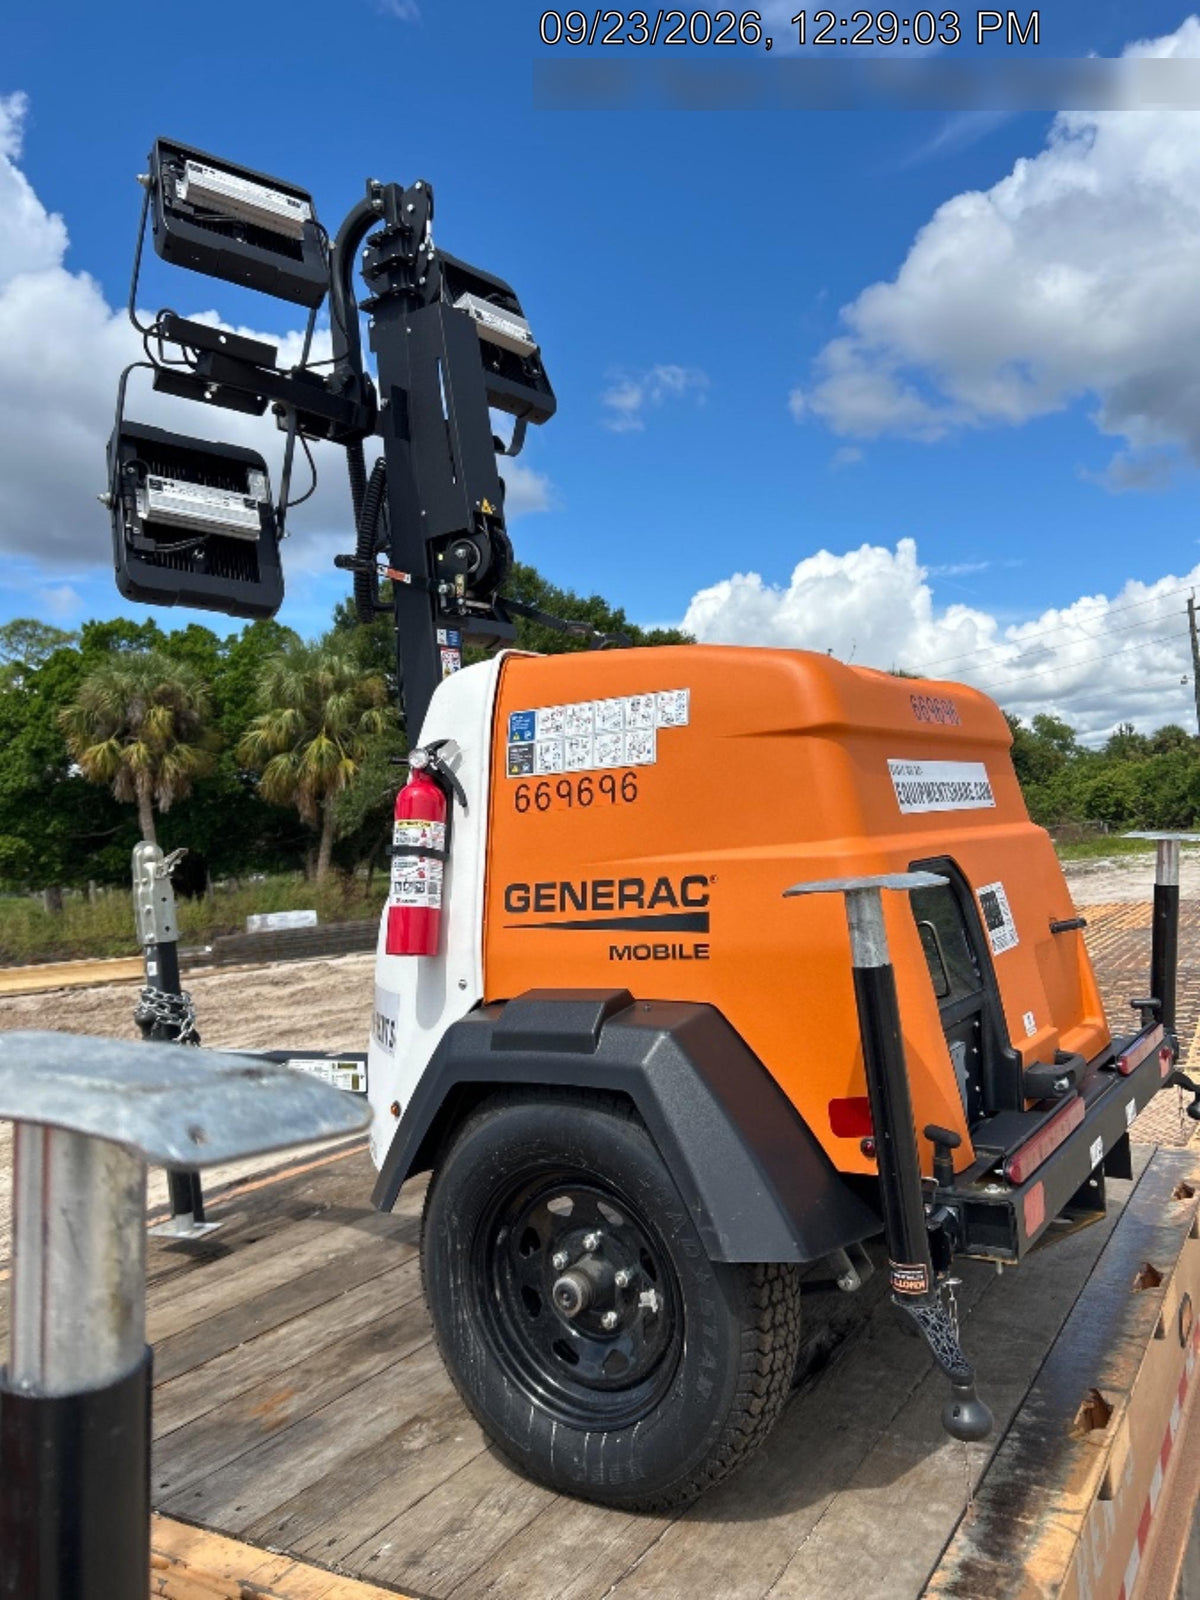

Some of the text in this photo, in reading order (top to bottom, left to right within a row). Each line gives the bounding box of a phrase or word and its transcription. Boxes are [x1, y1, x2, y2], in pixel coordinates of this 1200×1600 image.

[514, 772, 638, 813] 669696
[504, 874, 711, 914] GENERAC
[609, 943, 711, 961] MOBILE
